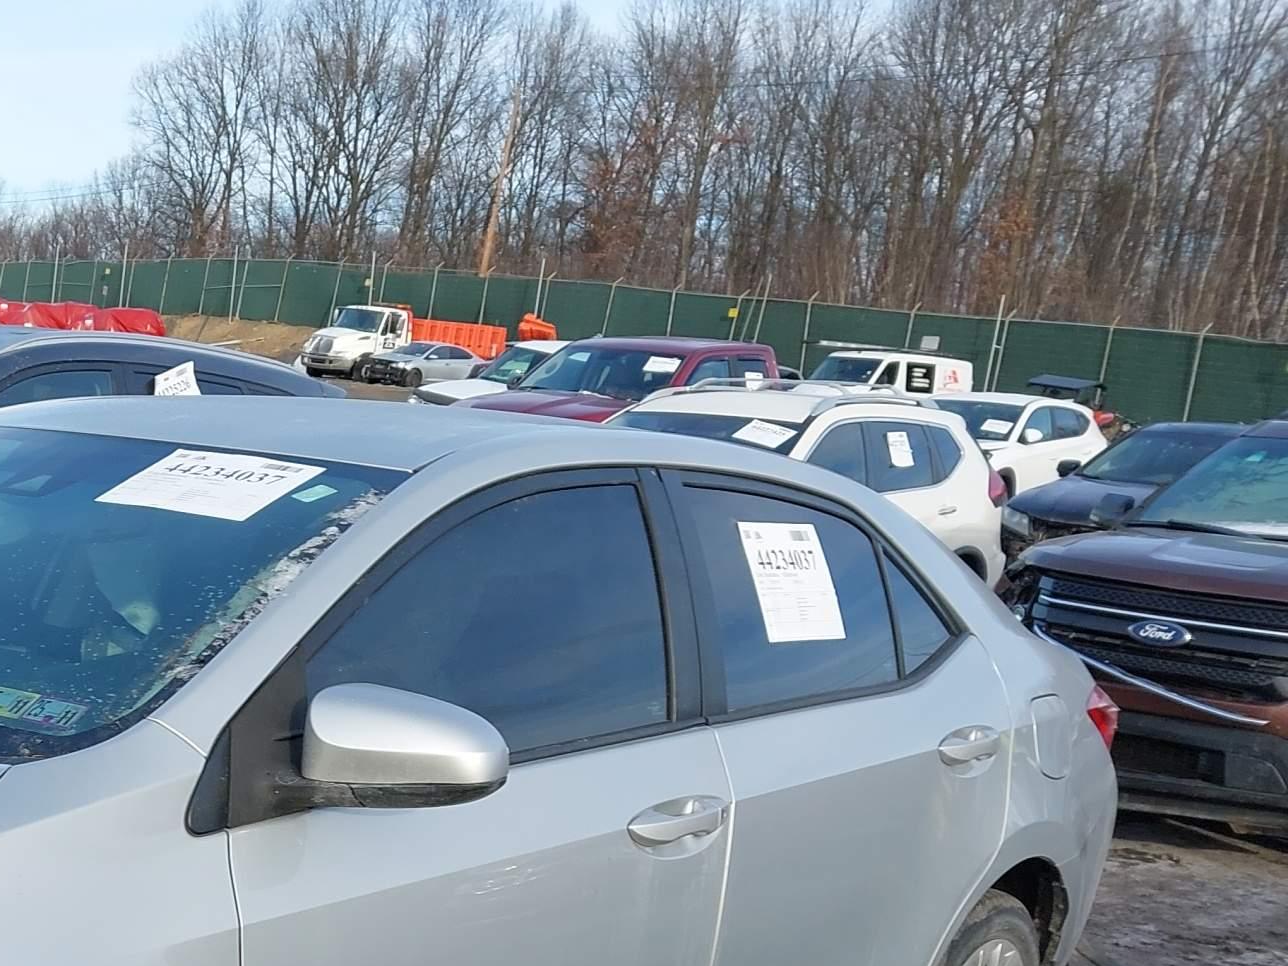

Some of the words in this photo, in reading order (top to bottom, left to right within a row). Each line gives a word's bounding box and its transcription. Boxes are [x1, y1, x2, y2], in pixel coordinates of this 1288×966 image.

[165, 463, 287, 486] 44234037
[758, 549, 816, 570] 44234037
[1139, 623, 1177, 641] Ford
[8, 699, 28, 715] 11
[56, 709, 78, 726] 11
